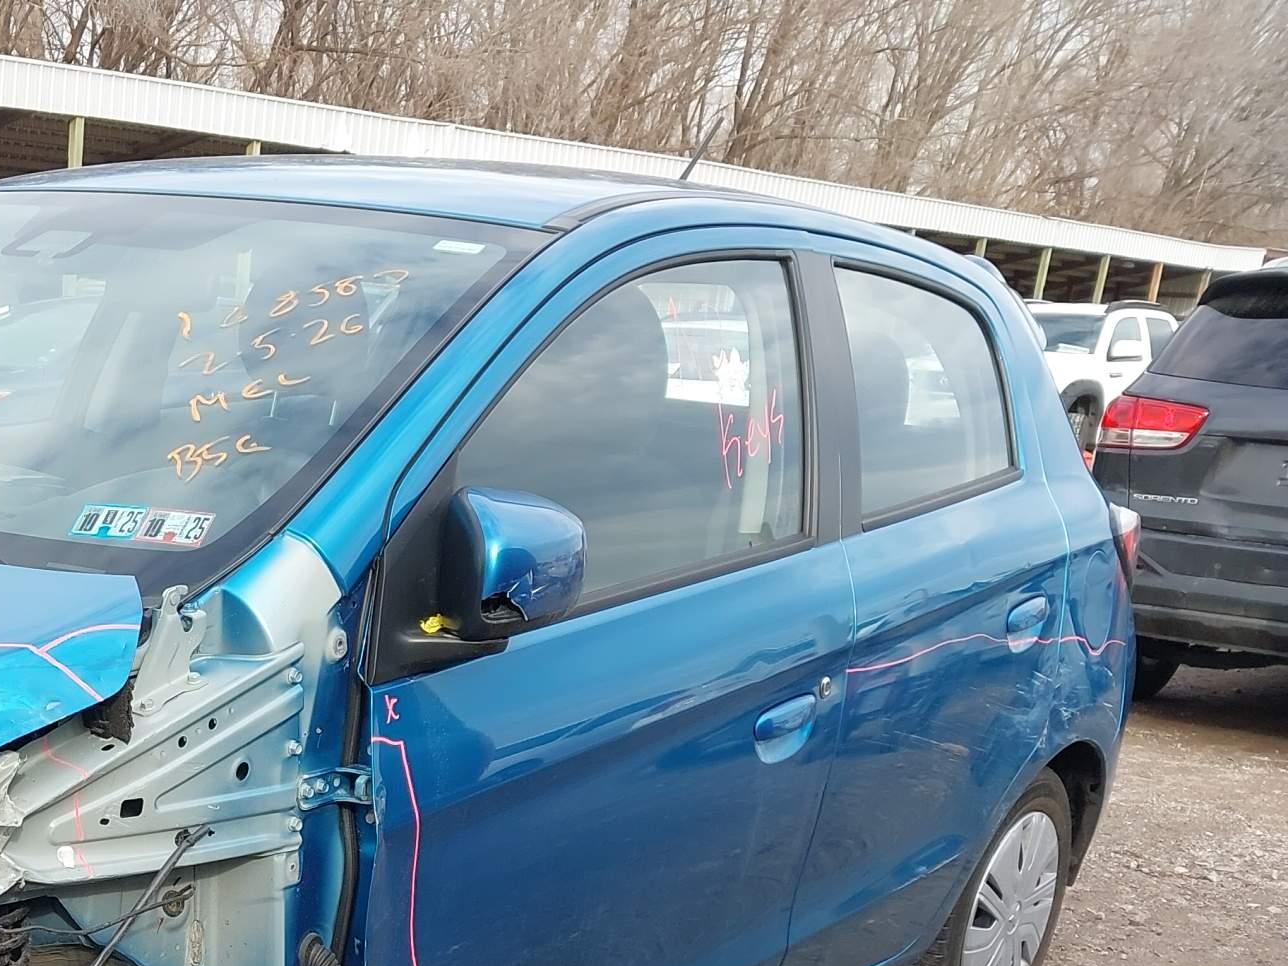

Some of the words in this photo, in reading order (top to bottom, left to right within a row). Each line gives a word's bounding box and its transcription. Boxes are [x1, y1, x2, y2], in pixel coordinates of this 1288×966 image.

[1132, 493, 1199, 505] SORENTO
[79, 512, 101, 532] 10
[118, 510, 144, 533] 25
[143, 517, 166, 538] 10
[184, 516, 211, 540] 25
